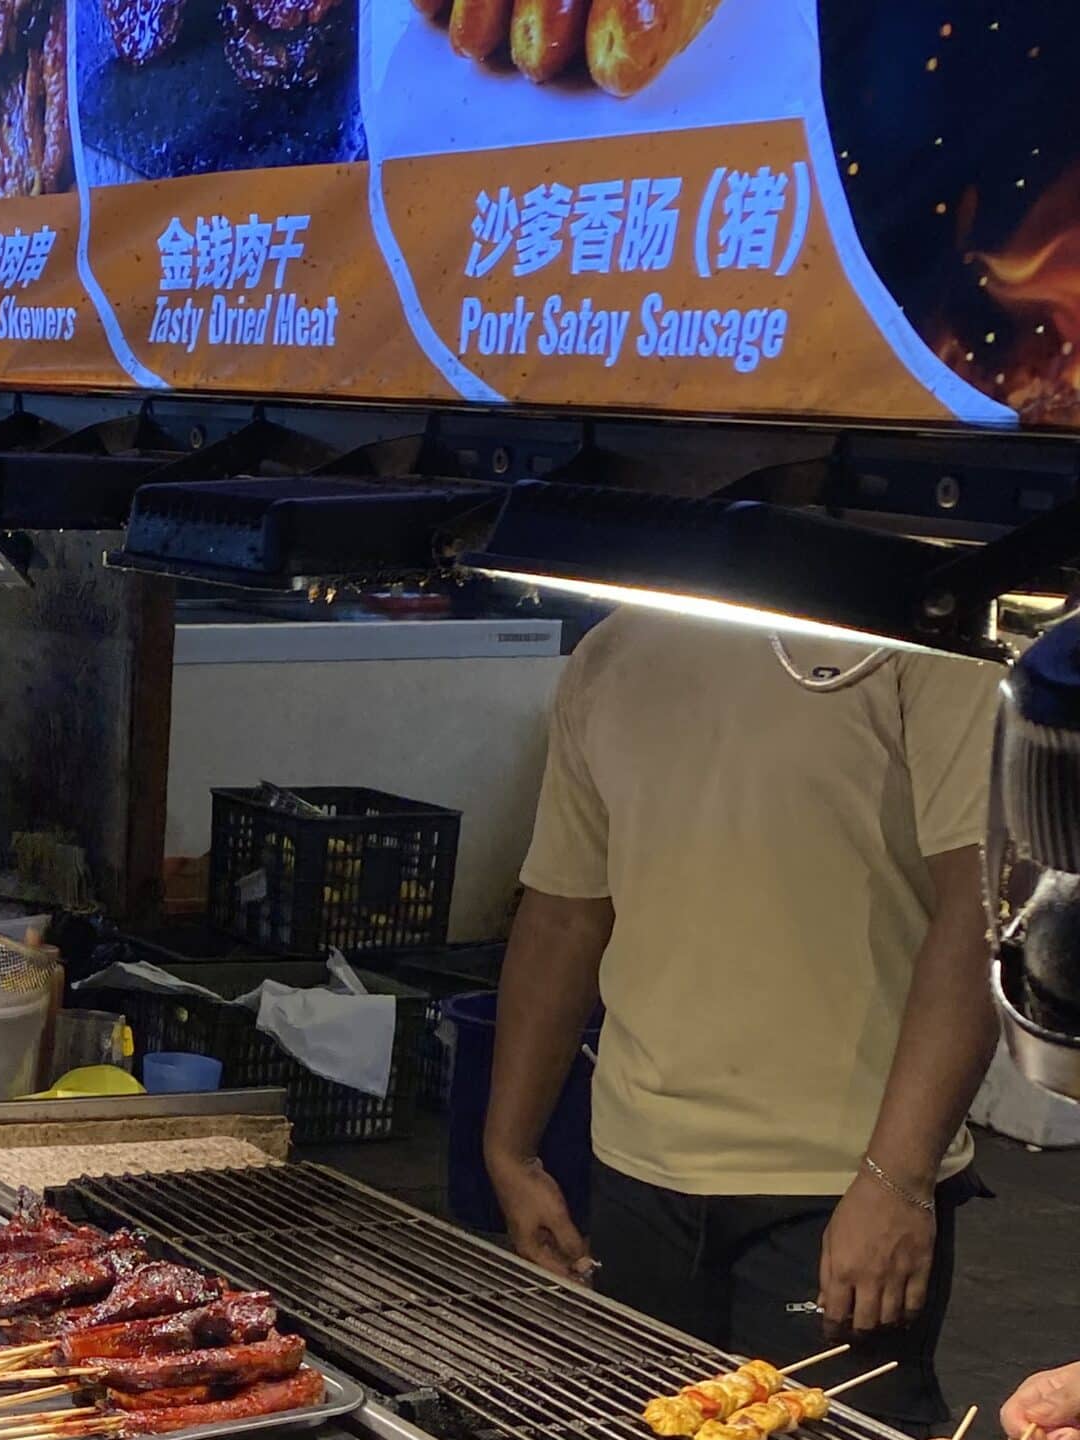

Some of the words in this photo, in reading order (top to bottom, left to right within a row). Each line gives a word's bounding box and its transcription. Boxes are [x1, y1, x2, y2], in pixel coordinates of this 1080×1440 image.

[157, 213, 311, 290] 金钱肉干
[148, 296, 204, 353] Tasty
[208, 294, 273, 345] Dried
[273, 293, 338, 346] Meat
[459, 296, 535, 355] Pork
[538, 294, 630, 368] Satay
[637, 291, 788, 374] Sausage
